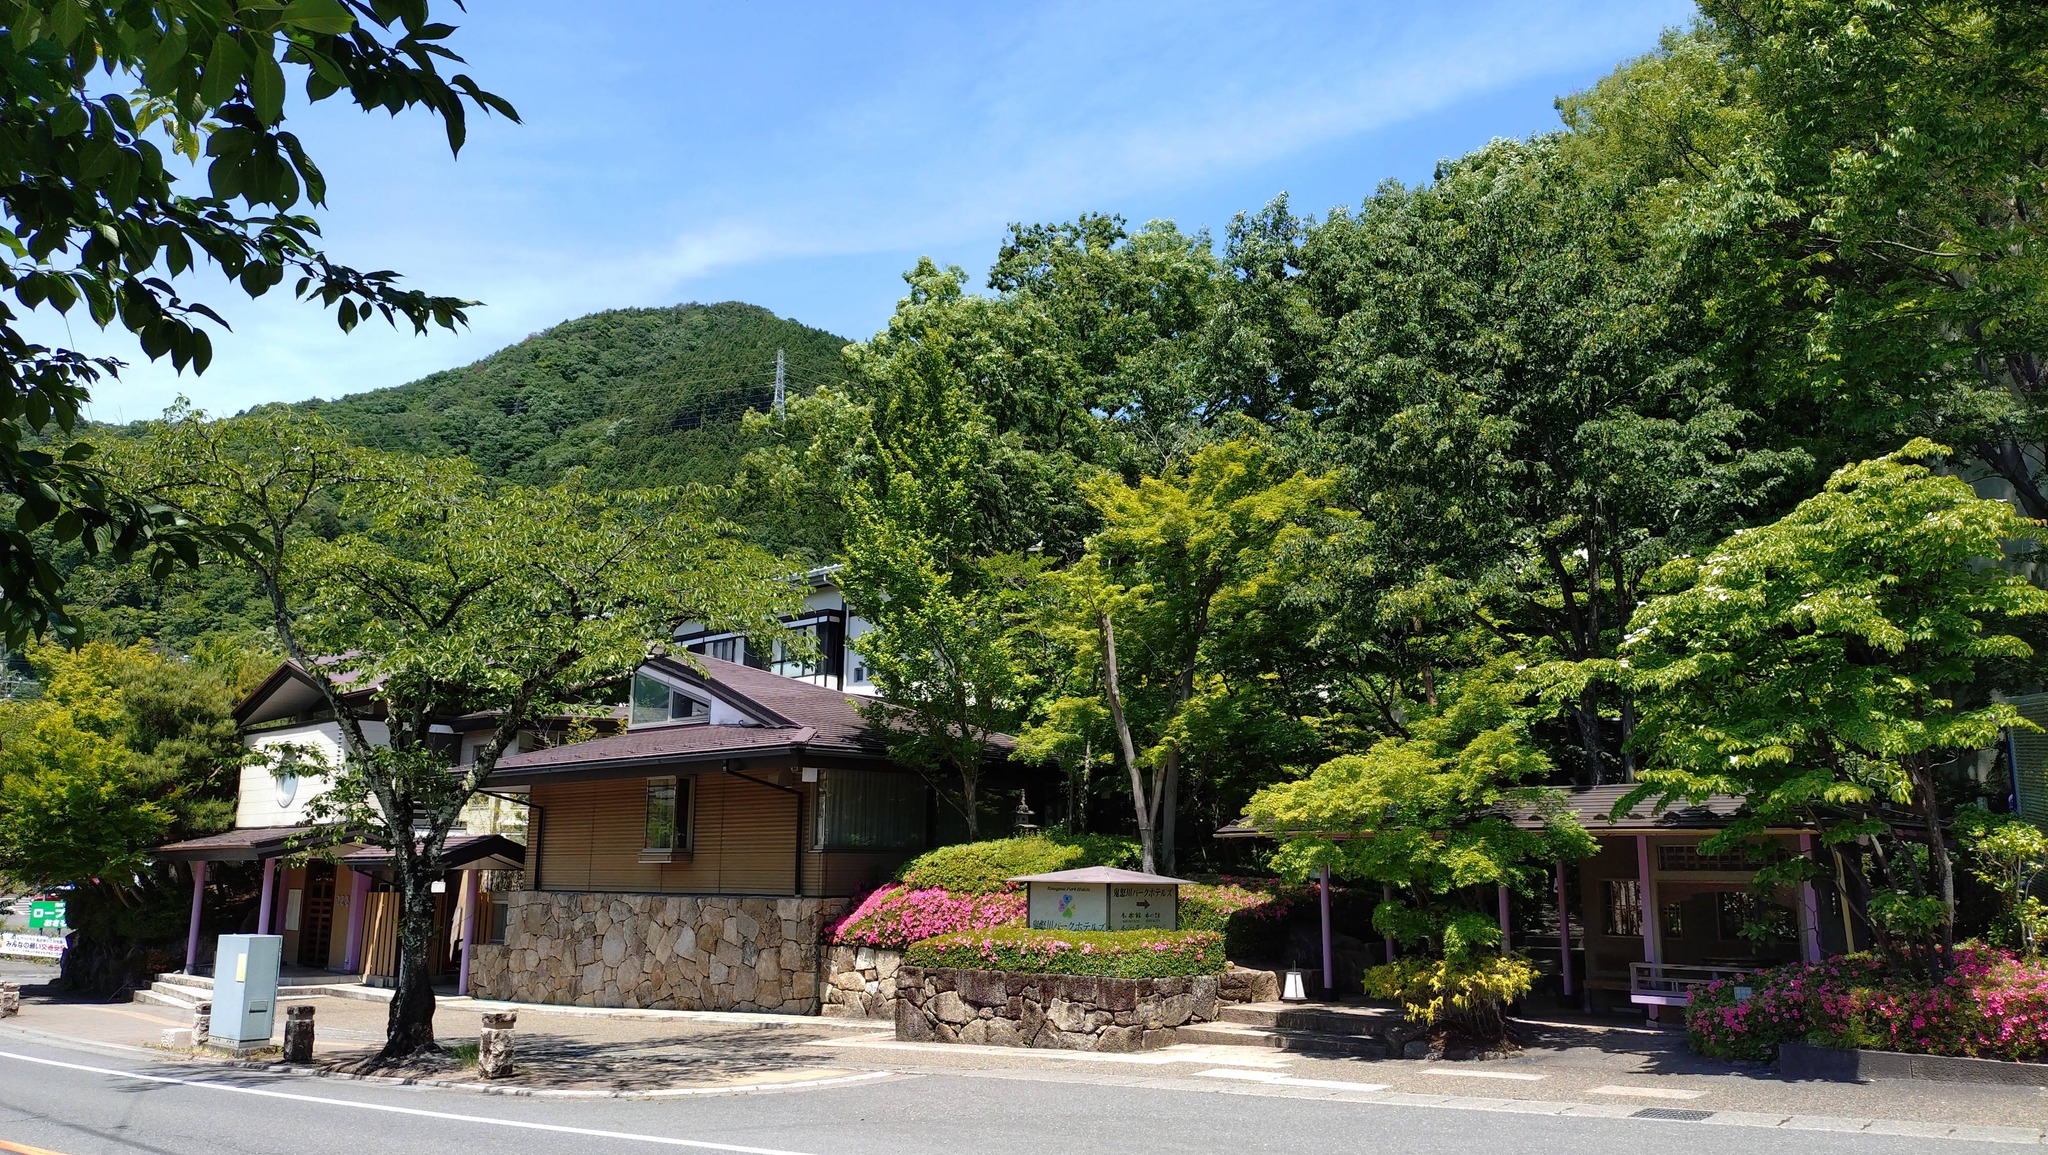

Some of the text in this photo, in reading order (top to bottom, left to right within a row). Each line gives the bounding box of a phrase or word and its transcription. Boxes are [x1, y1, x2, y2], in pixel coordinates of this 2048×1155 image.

[1113, 887, 1174, 898] 鬼怒川パークホテルズ
